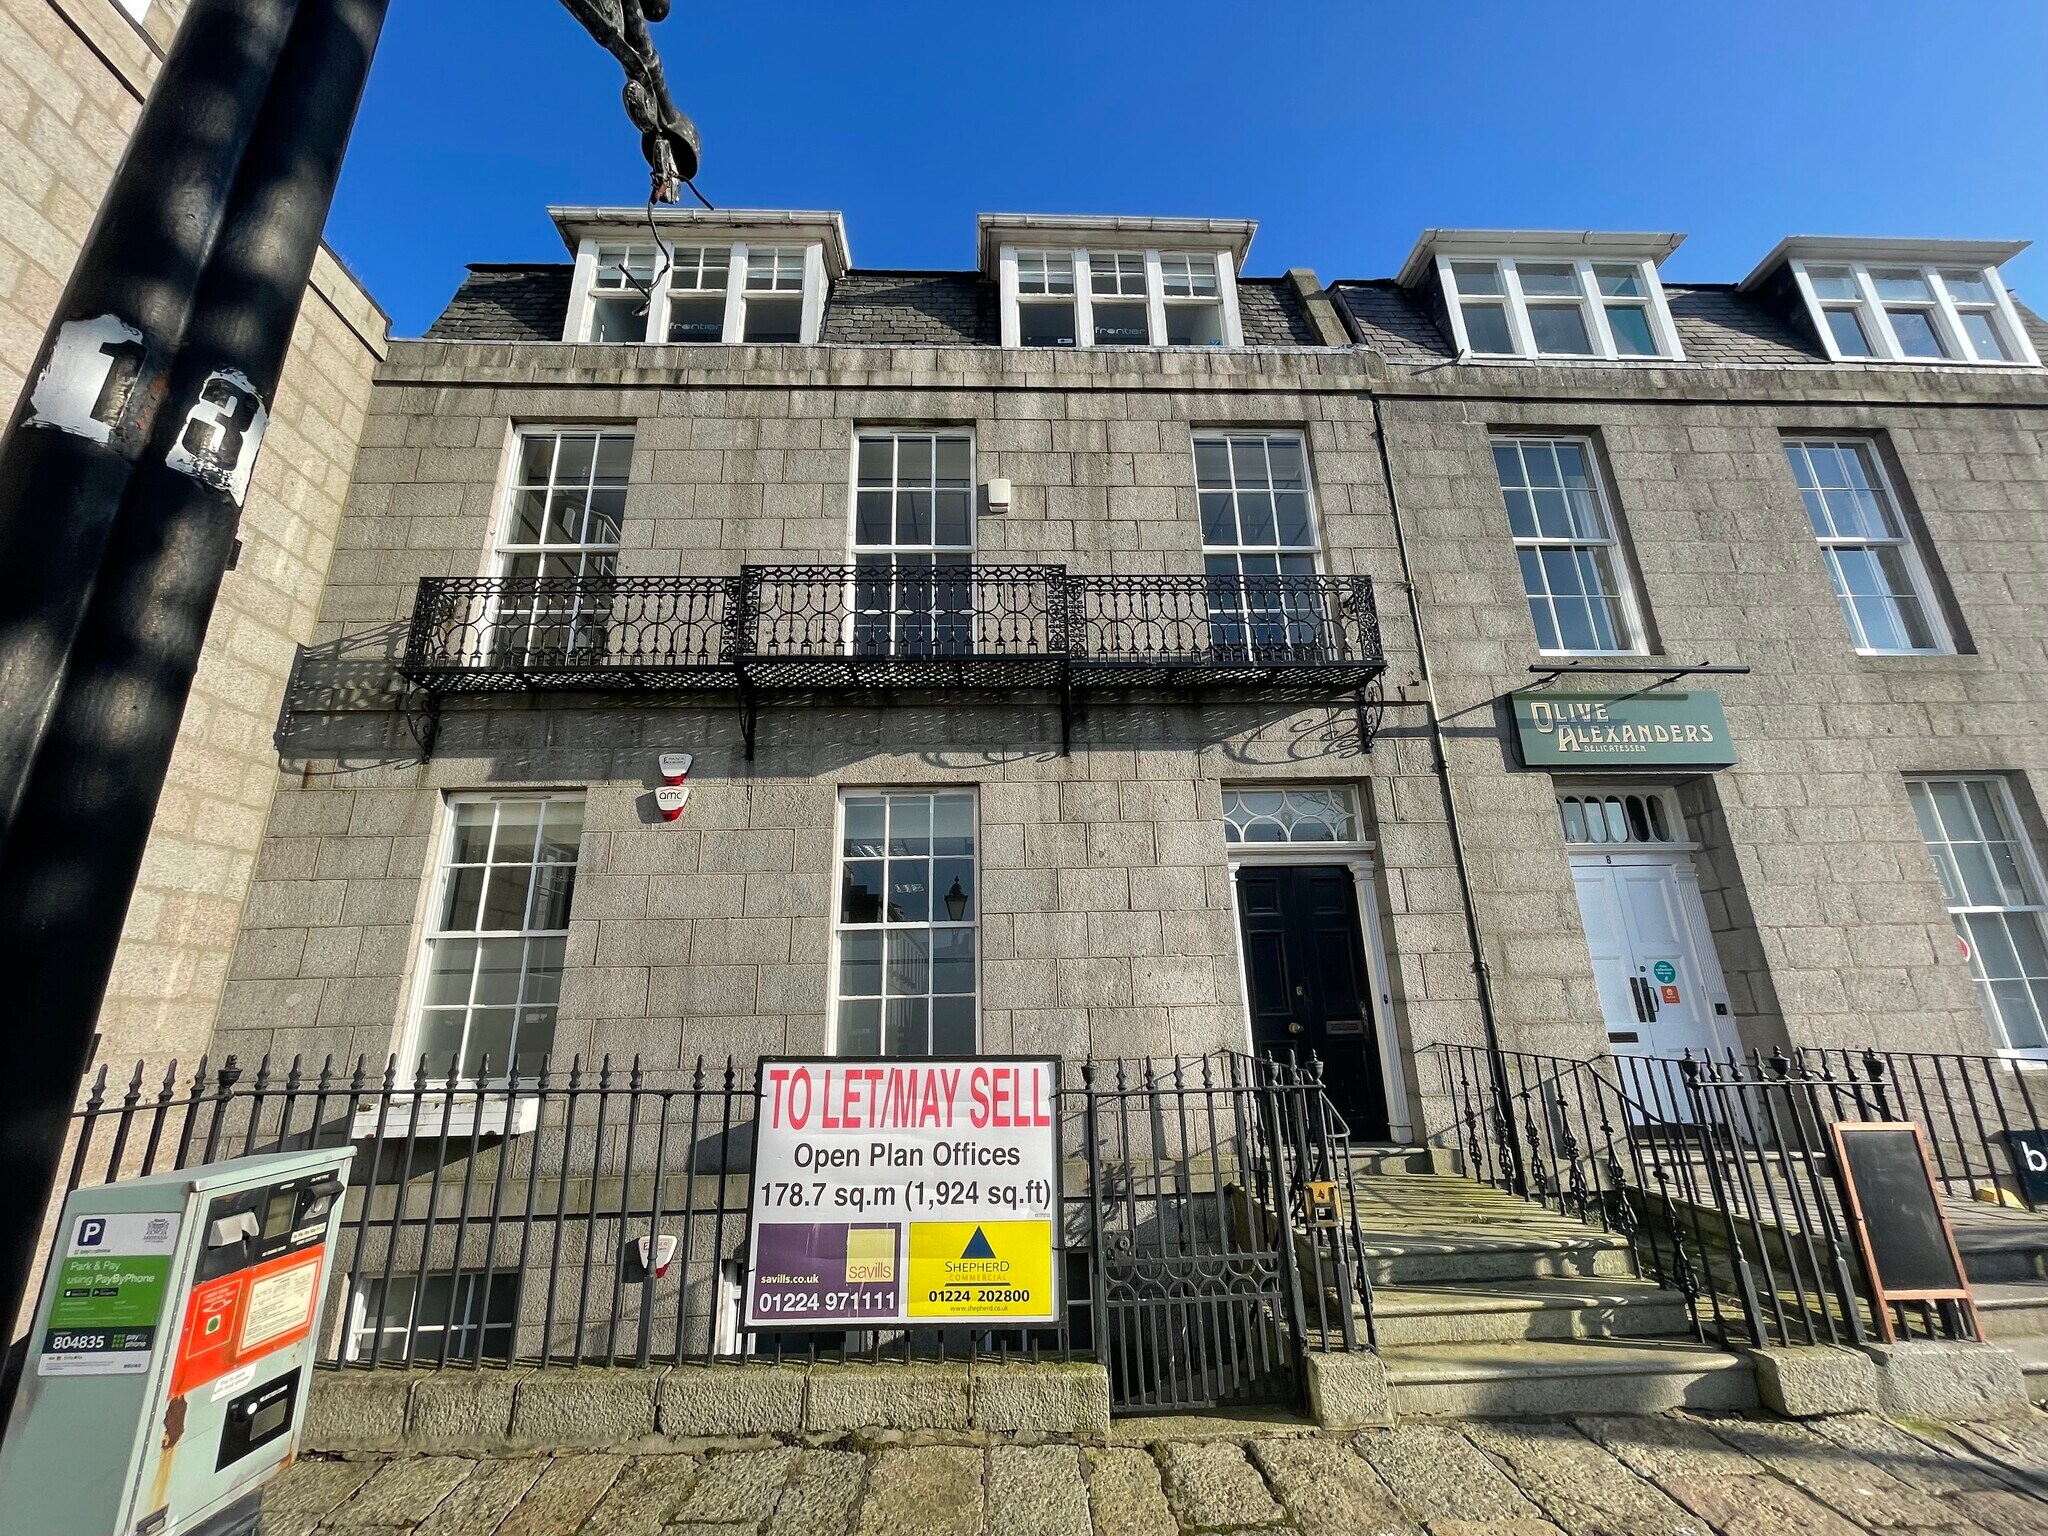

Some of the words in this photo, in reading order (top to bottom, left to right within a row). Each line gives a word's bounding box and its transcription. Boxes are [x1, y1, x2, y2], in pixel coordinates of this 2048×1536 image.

[1530, 702, 1609, 733] OLIVE
[1558, 724, 1714, 752] ALEXANDERS
[1584, 744, 1647, 753] DELICATESSEN
[659, 791, 682, 800] amc
[1605, 855, 1612, 865] 8
[769, 1067, 813, 1130] TO
[821, 1066, 961, 1129] LET/MAY
[969, 1066, 1051, 1129] SELL
[794, 1142, 860, 1173] Open
[869, 1142, 923, 1167] Plan
[932, 1141, 1021, 1167] Offices
[761, 1182, 827, 1207] 178.7
[834, 1186, 896, 1212] sq.m
[904, 1180, 979, 1211] (1,924
[987, 1179, 1051, 1210] sq.ft)
[83, 1222, 102, 1243] P
[70, 1262, 91, 1271] Park
[93, 1261, 101, 1270] &
[103, 1261, 121, 1272] Pay
[848, 1262, 892, 1279] savills
[944, 1261, 1010, 1273] SHEPHERD
[67, 1276, 93, 1286] using
[95, 1274, 155, 1286] PayByPhone
[760, 1273, 820, 1284] savills.co.uk
[949, 1274, 1007, 1282] COMMERCIAL
[759, 1292, 820, 1312] 01224
[825, 1291, 895, 1311] 971111
[928, 1290, 971, 1303] 01224
[977, 1289, 1030, 1302] 202800
[950, 1304, 1009, 1312] www.shepherd.co.uk
[52, 1335, 105, 1350] 804835
[124, 1341, 147, 1349] phone
